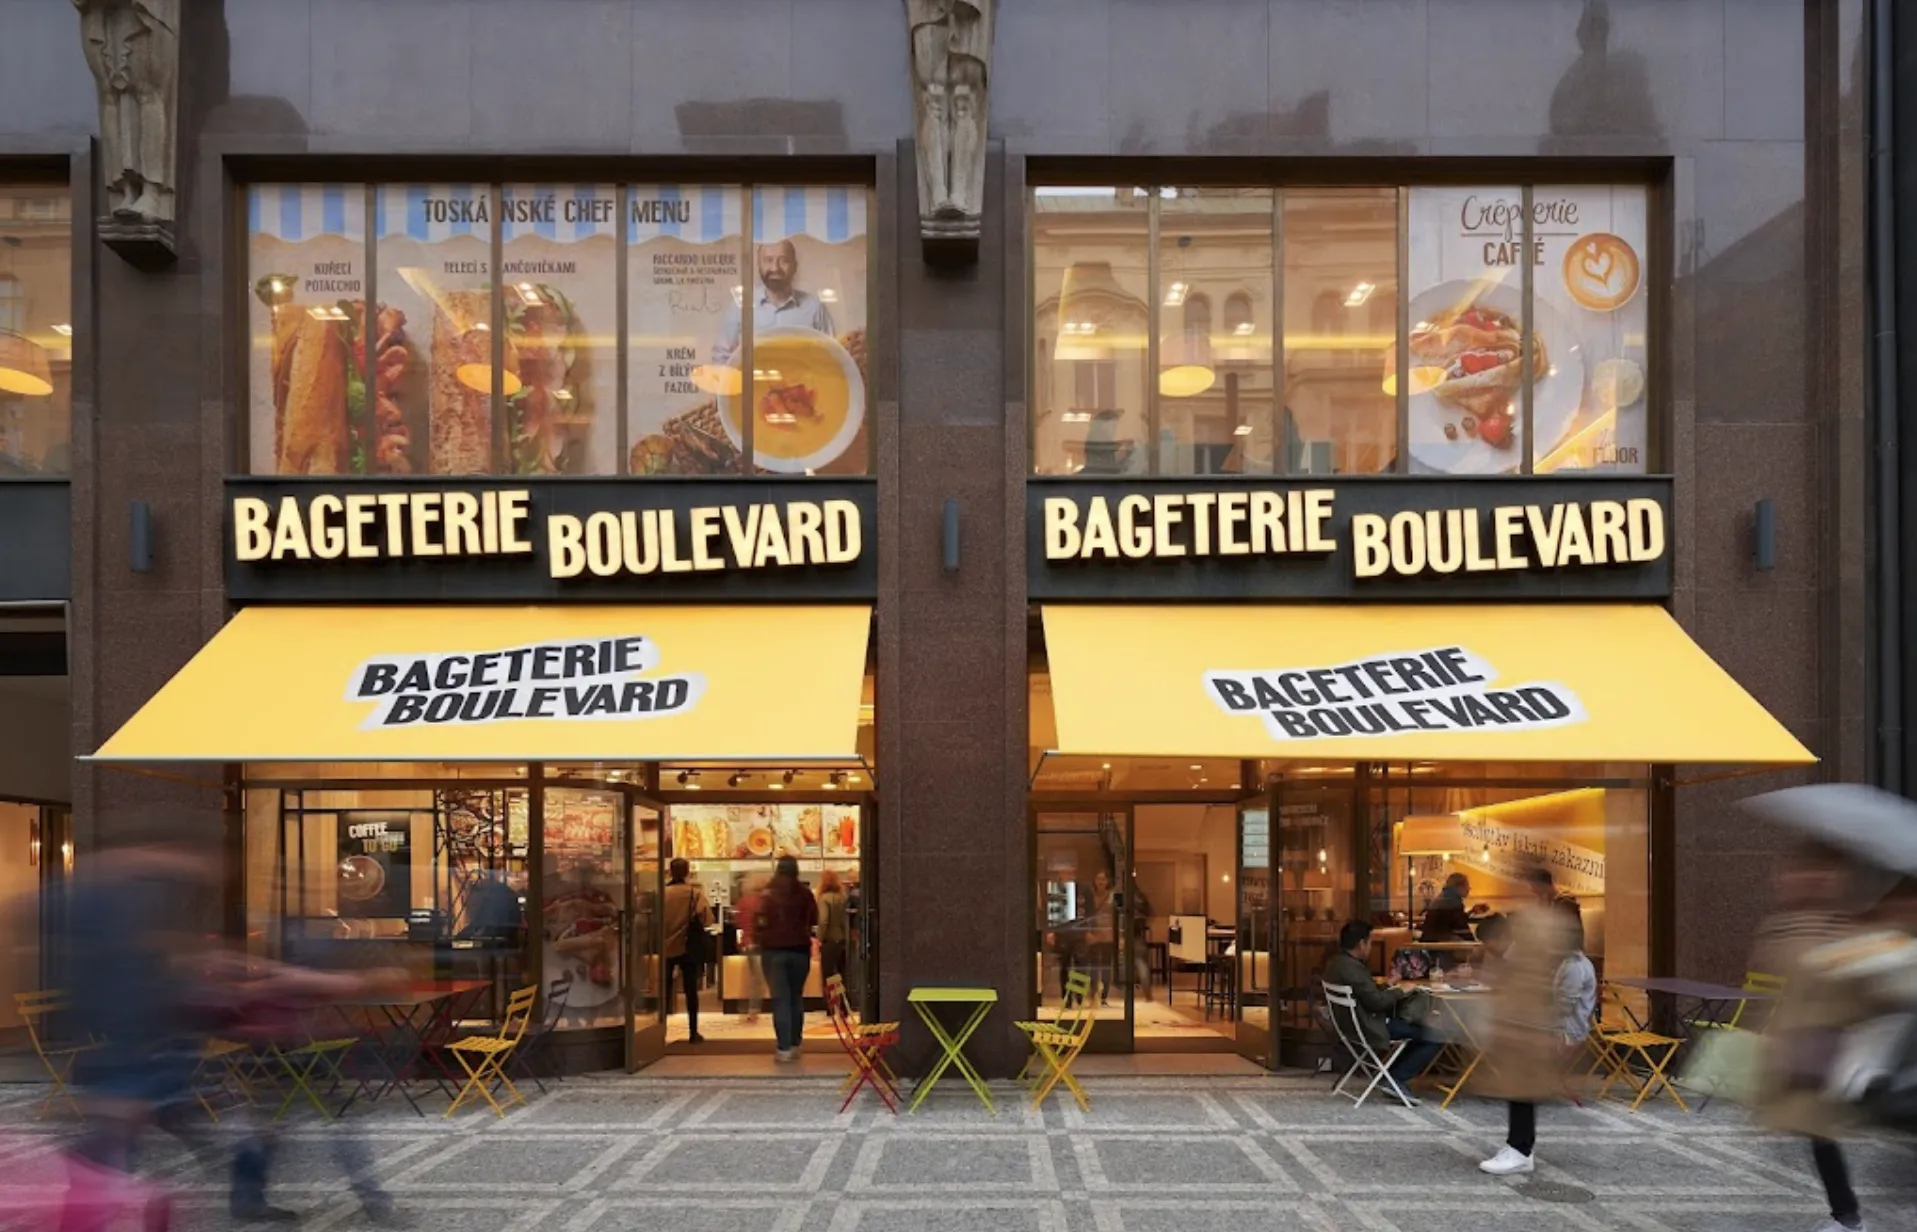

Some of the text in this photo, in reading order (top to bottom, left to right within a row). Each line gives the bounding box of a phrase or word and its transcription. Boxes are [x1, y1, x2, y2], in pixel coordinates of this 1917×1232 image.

[564, 200, 613, 223] CHEF
[632, 200, 690, 223] MENU
[444, 260, 477, 274] TELECÍ
[481, 263, 487, 274] S
[659, 365, 665, 377] Z
[666, 346, 696, 360] KRÉM
[234, 490, 862, 579] BAGETERIE BOULEVARD
[1044, 489, 1665, 578] BAGETERIE BOULEVARD
[357, 636, 643, 697] BAGETERIE
[1211, 646, 1485, 711] BAGETERIE
[383, 678, 689, 725] BOULEVARD
[1271, 687, 1572, 739] BOULEVARD
[362, 839, 377, 852] TO
